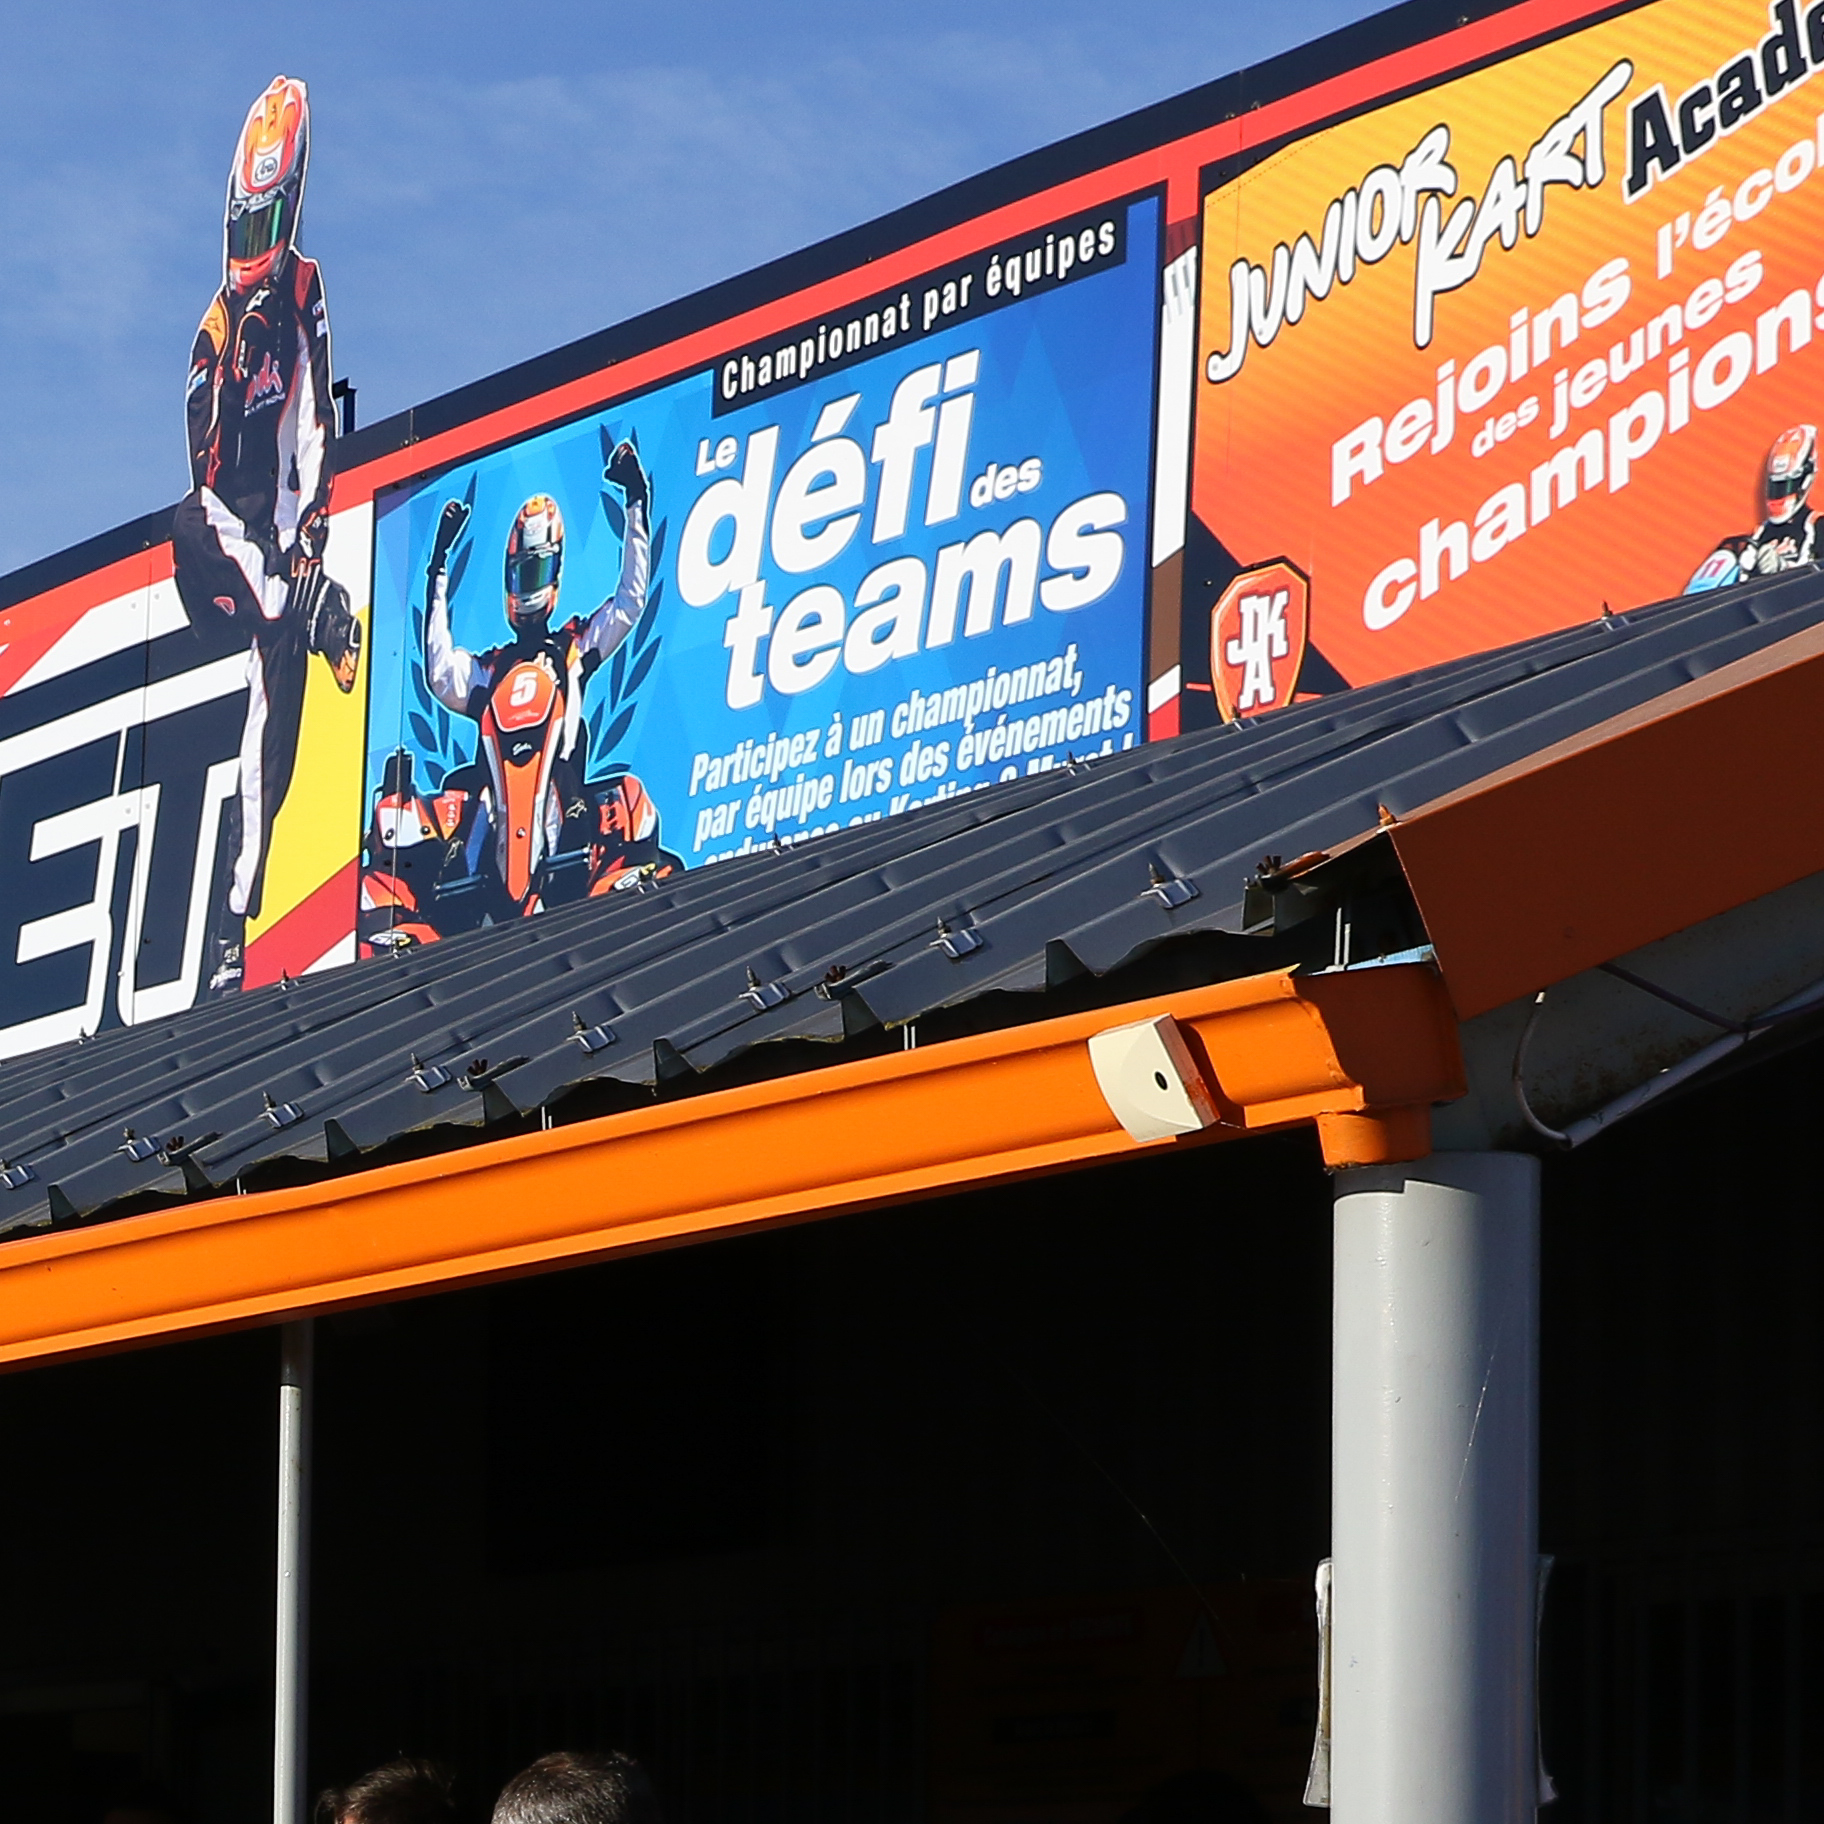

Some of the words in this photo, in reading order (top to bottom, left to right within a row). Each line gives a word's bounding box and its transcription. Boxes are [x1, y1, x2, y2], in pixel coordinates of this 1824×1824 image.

[1206, 123, 1456, 382] JUNIOR
[1413, 59, 1633, 346] KART
[722, 292, 911, 399] Championnat
[923, 271, 974, 331] par
[985, 220, 1115, 296] équipes
[1331, 257, 1630, 506] Rejoins
[1471, 395, 1539, 457] des
[1550, 251, 1764, 438] jeunes
[677, 349, 981, 608] défi
[695, 434, 737, 477] Le
[969, 456, 1042, 509] des
[1363, 272, 1824, 631] champion
[508, 672, 538, 707] 5
[723, 491, 1127, 711] teams
[689, 726, 817, 797] Participez
[825, 713, 843, 755] à
[850, 708, 886, 752] un
[891, 643, 1084, 739] championnat,
[693, 794, 749, 852] par
[744, 771, 835, 835] équipe
[839, 757, 891, 804] lors
[899, 741, 949, 788] des
[956, 684, 1133, 772] événements
